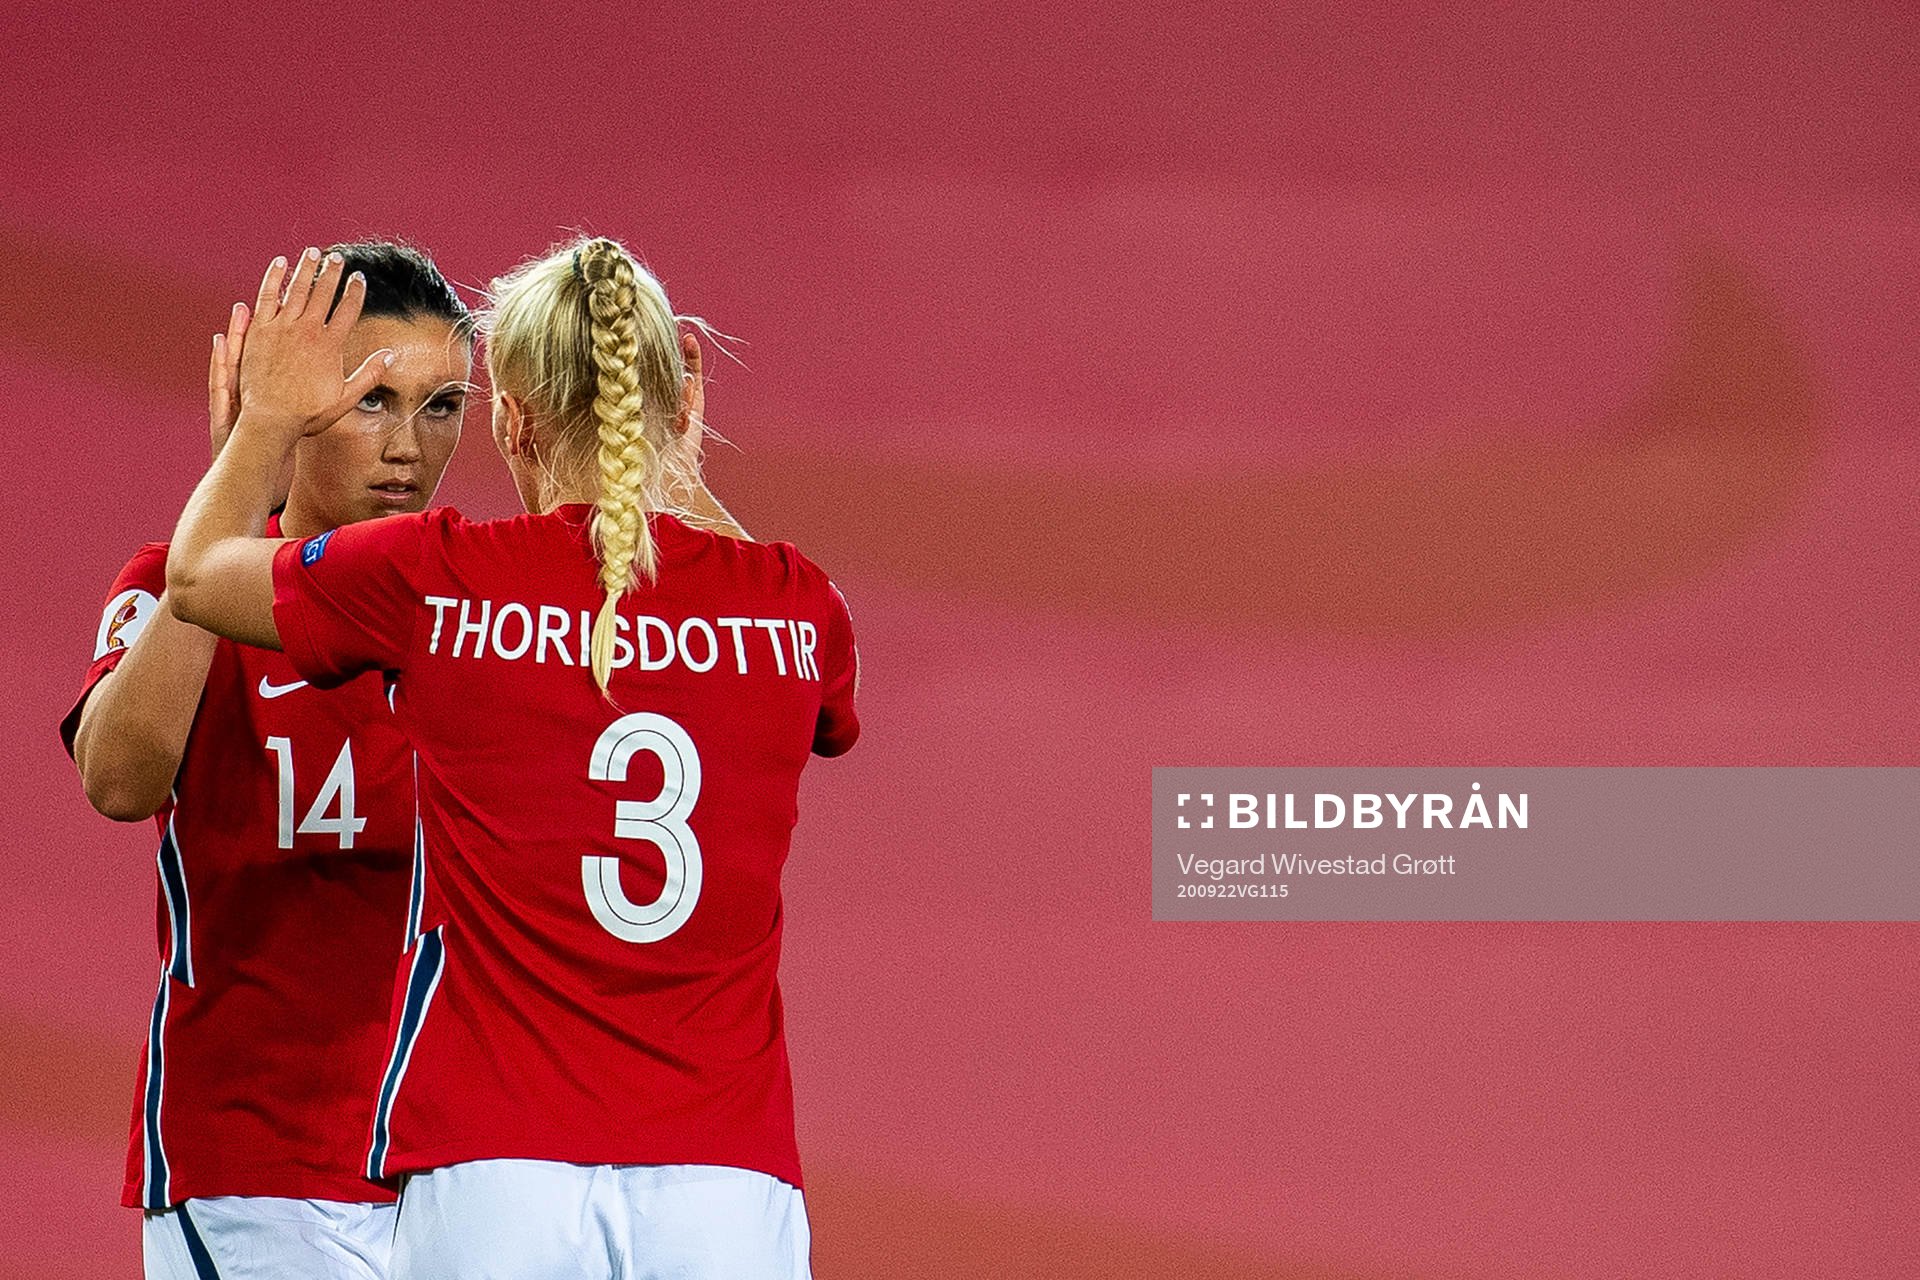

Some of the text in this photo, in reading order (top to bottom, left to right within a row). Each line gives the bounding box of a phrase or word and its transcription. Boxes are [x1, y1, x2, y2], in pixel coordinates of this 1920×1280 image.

[425, 595, 820, 682] THORISDOTTIR
[264, 735, 368, 850] 14
[581, 711, 703, 944] 3
